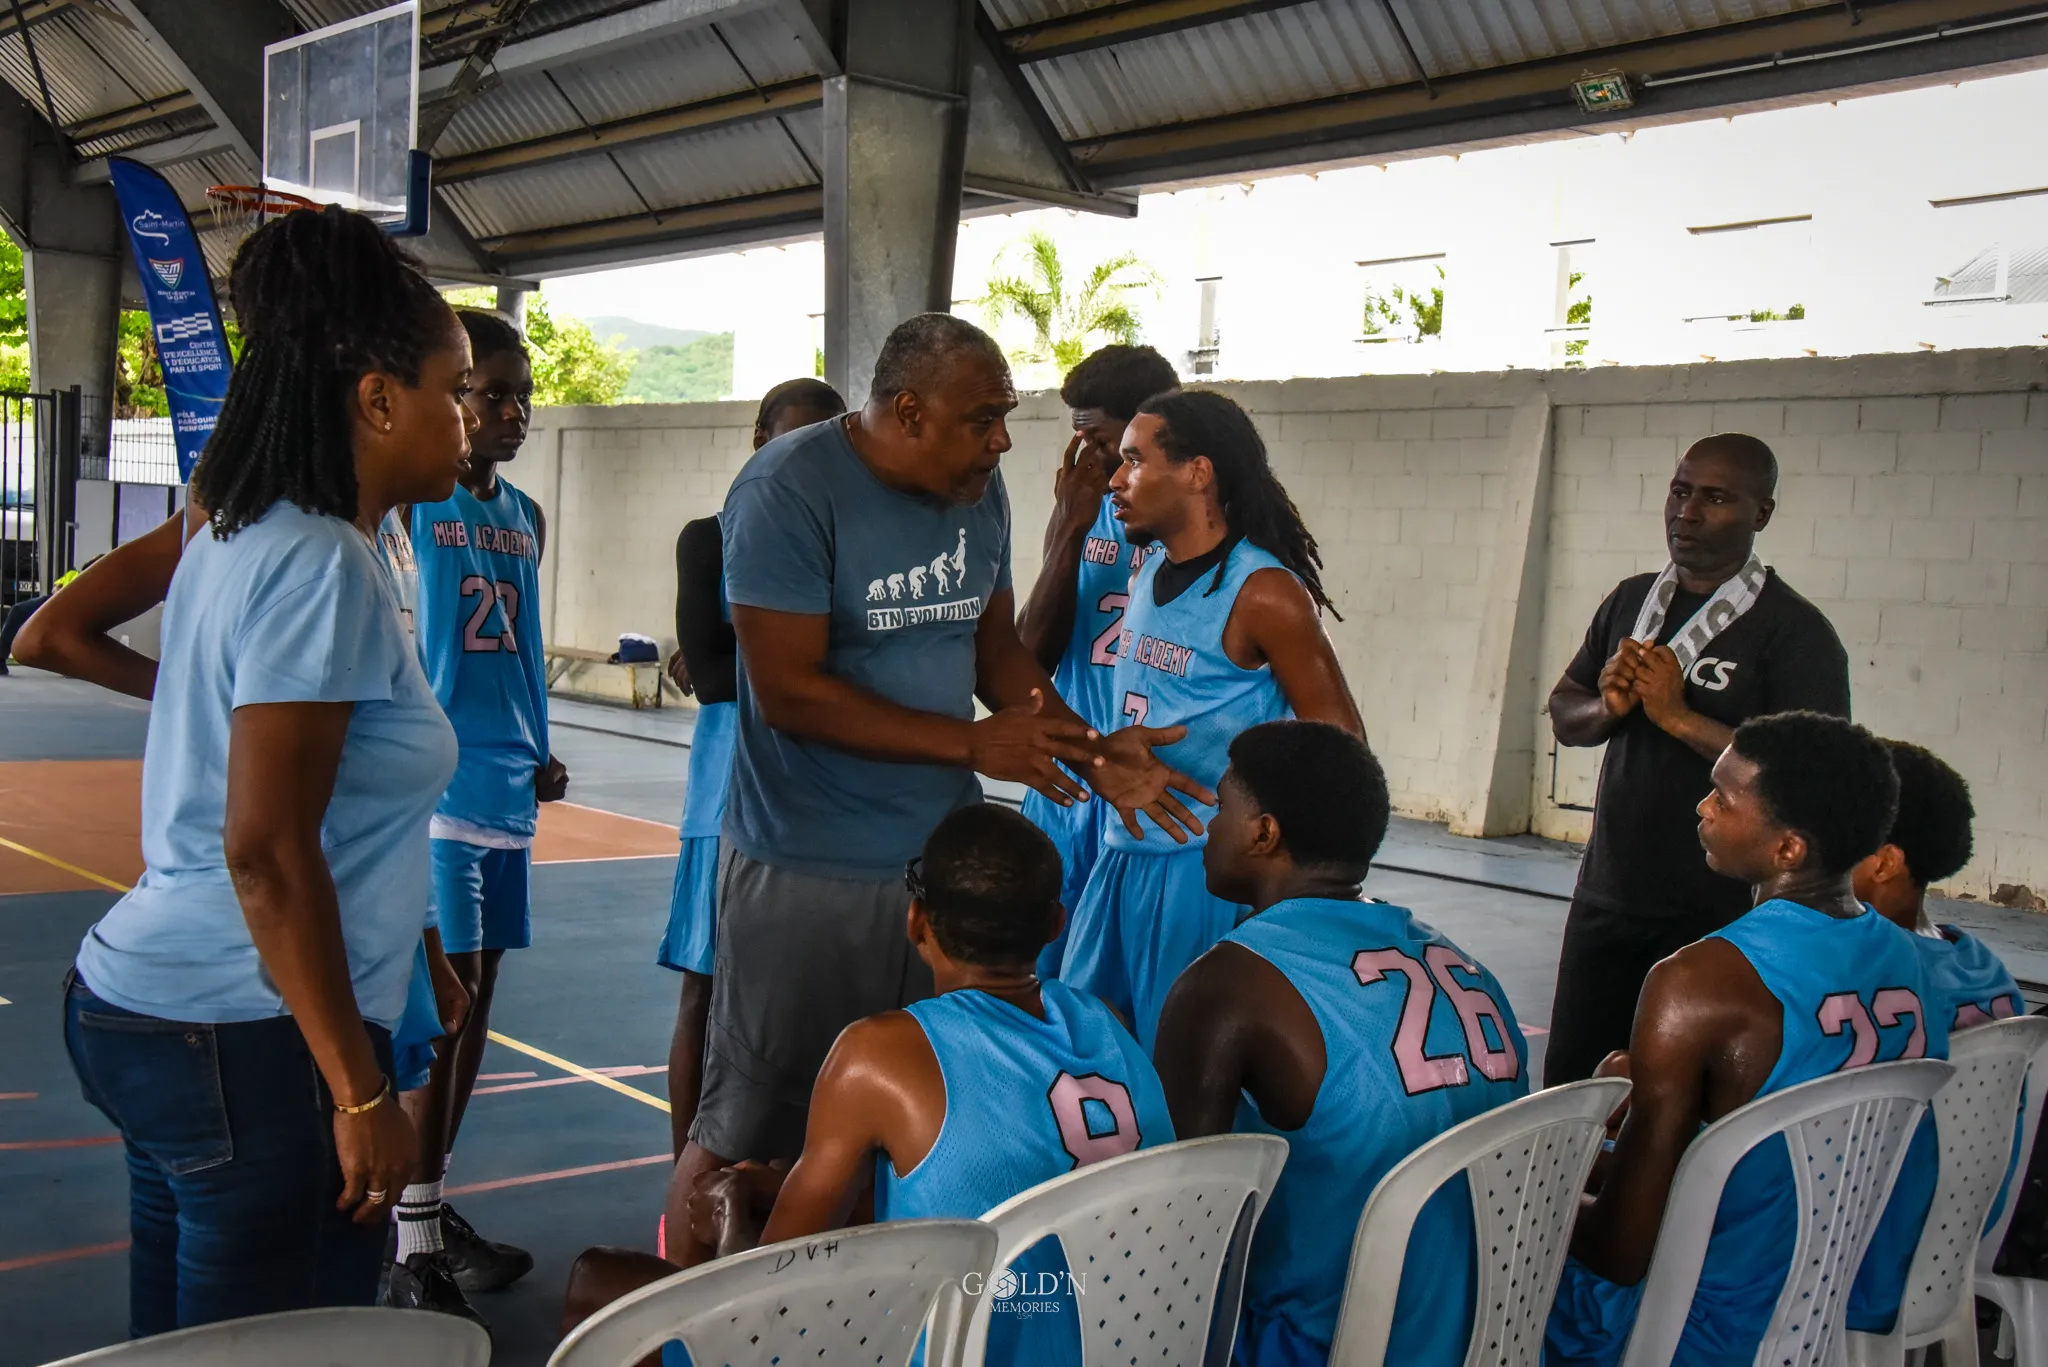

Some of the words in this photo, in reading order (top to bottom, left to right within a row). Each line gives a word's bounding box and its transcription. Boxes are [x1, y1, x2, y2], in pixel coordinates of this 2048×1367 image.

[138, 219, 186, 229] Saint-Martin
[163, 349, 220, 359] D'EXCELLENCE
[189, 341, 217, 349] CENTRE
[169, 366, 186, 374] PAR
[186, 364, 197, 373] LE
[198, 363, 222, 372] SPORT
[178, 423, 216, 432] PERFORM
[433, 521, 468, 548] MHB
[1083, 537, 1120, 566] MHB
[460, 575, 519, 653] 23
[905, 598, 980, 626] EVOLUTION
[1134, 633, 1193, 677] ACADEMY
[1350, 944, 1519, 1097] 26
